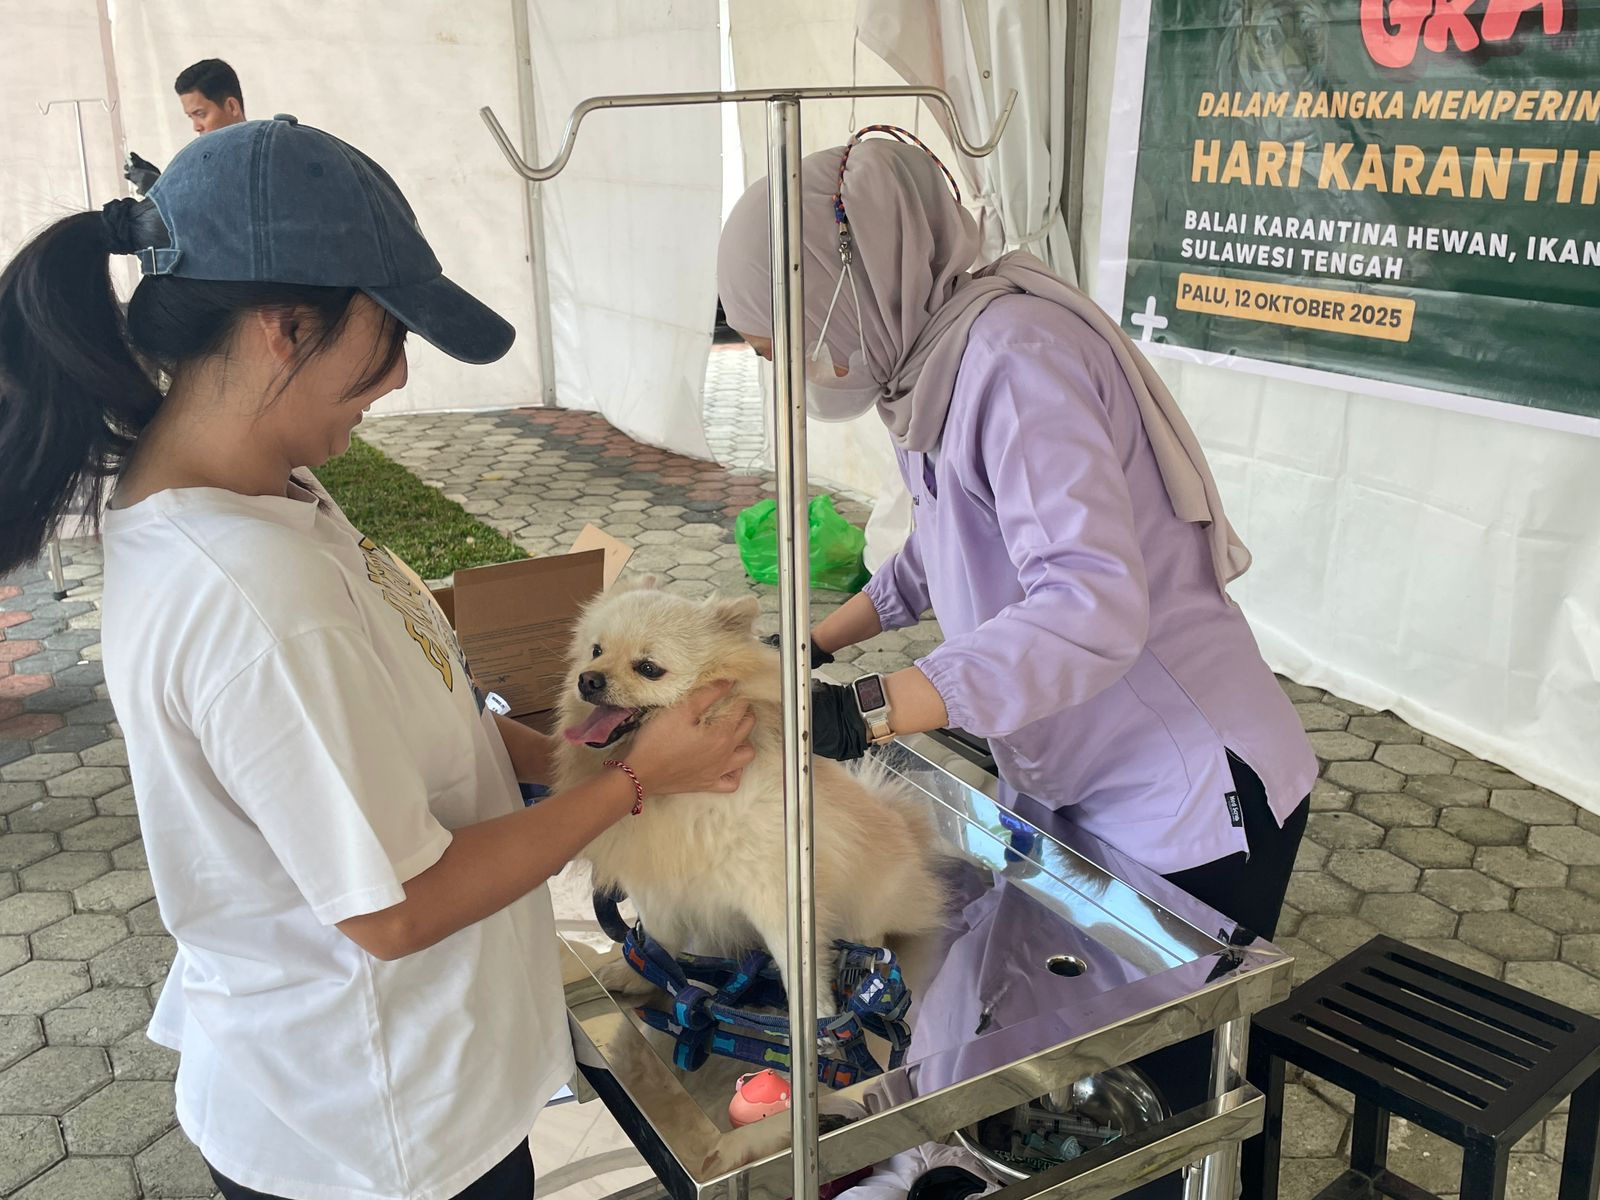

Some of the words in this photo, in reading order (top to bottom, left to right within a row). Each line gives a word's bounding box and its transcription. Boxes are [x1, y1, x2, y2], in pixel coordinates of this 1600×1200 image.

[1198, 91, 1289, 117] DALAM
[1293, 91, 1403, 118] RANGKA
[1412, 90, 1600, 121] MEMPERIN
[1191, 139, 1305, 188] HARI
[1180, 238, 1294, 269] SULAWESI
[1301, 249, 1403, 280] TENGAH
[1184, 209, 1247, 234] BALAI
[1253, 214, 1398, 247] KARANTINA
[1407, 226, 1517, 263] HEWAN,
[1526, 236, 1600, 267] IKAN
[1181, 283, 1230, 308] PALU,
[1235, 288, 1251, 308] 12
[1254, 292, 1345, 321] OKTOBER
[1349, 304, 1403, 328] 2025
